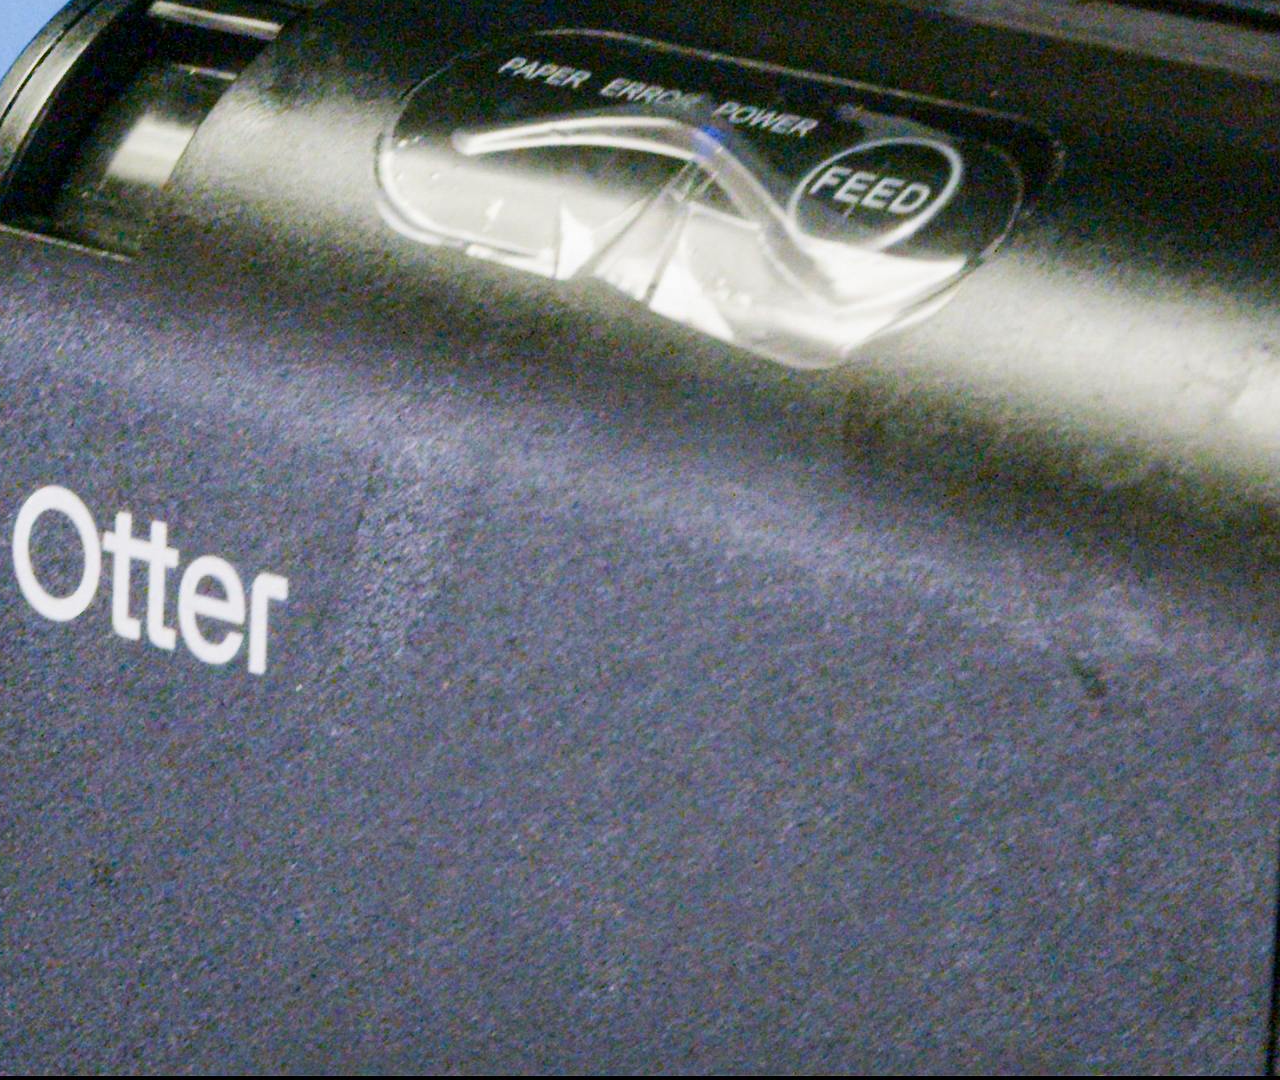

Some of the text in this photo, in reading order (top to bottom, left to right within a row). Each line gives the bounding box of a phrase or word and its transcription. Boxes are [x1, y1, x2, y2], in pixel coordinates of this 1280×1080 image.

[498, 56, 592, 89] PAPER
[712, 101, 820, 138] POWER
[811, 164, 932, 214] FEED
[12, 484, 290, 676] Otter
